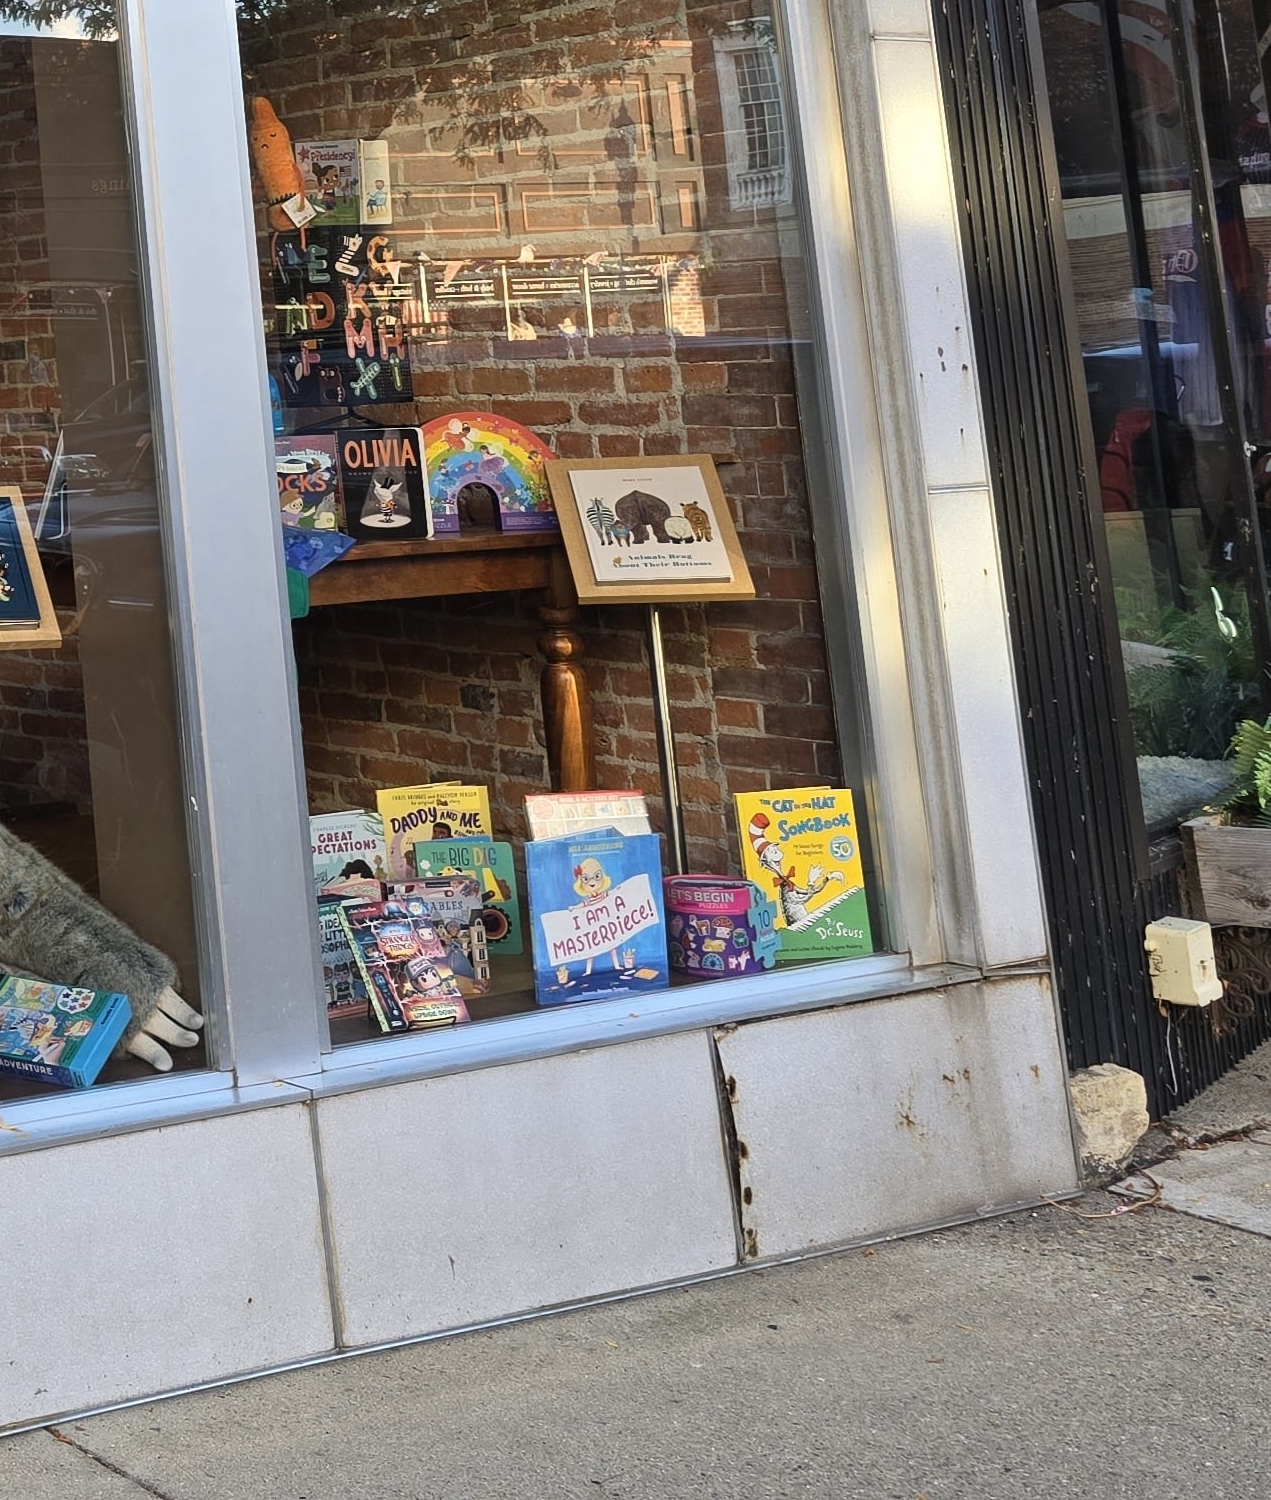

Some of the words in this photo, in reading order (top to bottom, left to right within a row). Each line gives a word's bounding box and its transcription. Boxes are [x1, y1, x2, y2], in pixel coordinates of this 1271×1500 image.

[310, 149, 356, 162] Presidency!
[345, 438, 417, 469] OLIVIA
[772, 799, 794, 813] CAT
[810, 796, 836, 810] HAT
[390, 806, 438, 834] DADDY
[439, 812, 458, 822] AND
[460, 812, 482, 829] ME
[778, 812, 852, 842] SONGBOOK
[318, 831, 354, 843] GREAT
[431, 851, 447, 864] THE
[448, 847, 470, 867] BIG
[473, 847, 497, 866] DIG
[833, 842, 851, 856] 50
[666, 888, 691, 901] LET'S
[693, 891, 735, 903] BEGIN
[572, 915, 581, 930] I
[588, 907, 609, 927] AM
[614, 895, 626, 912] A
[757, 909, 771, 928] 10
[552, 899, 655, 960] MASTERPIECE!
[815, 926, 835, 940] Dr.
[835, 922, 864, 939] Seuss
[379, 933, 417, 947] STRANGER
[386, 941, 414, 953] THINGS
